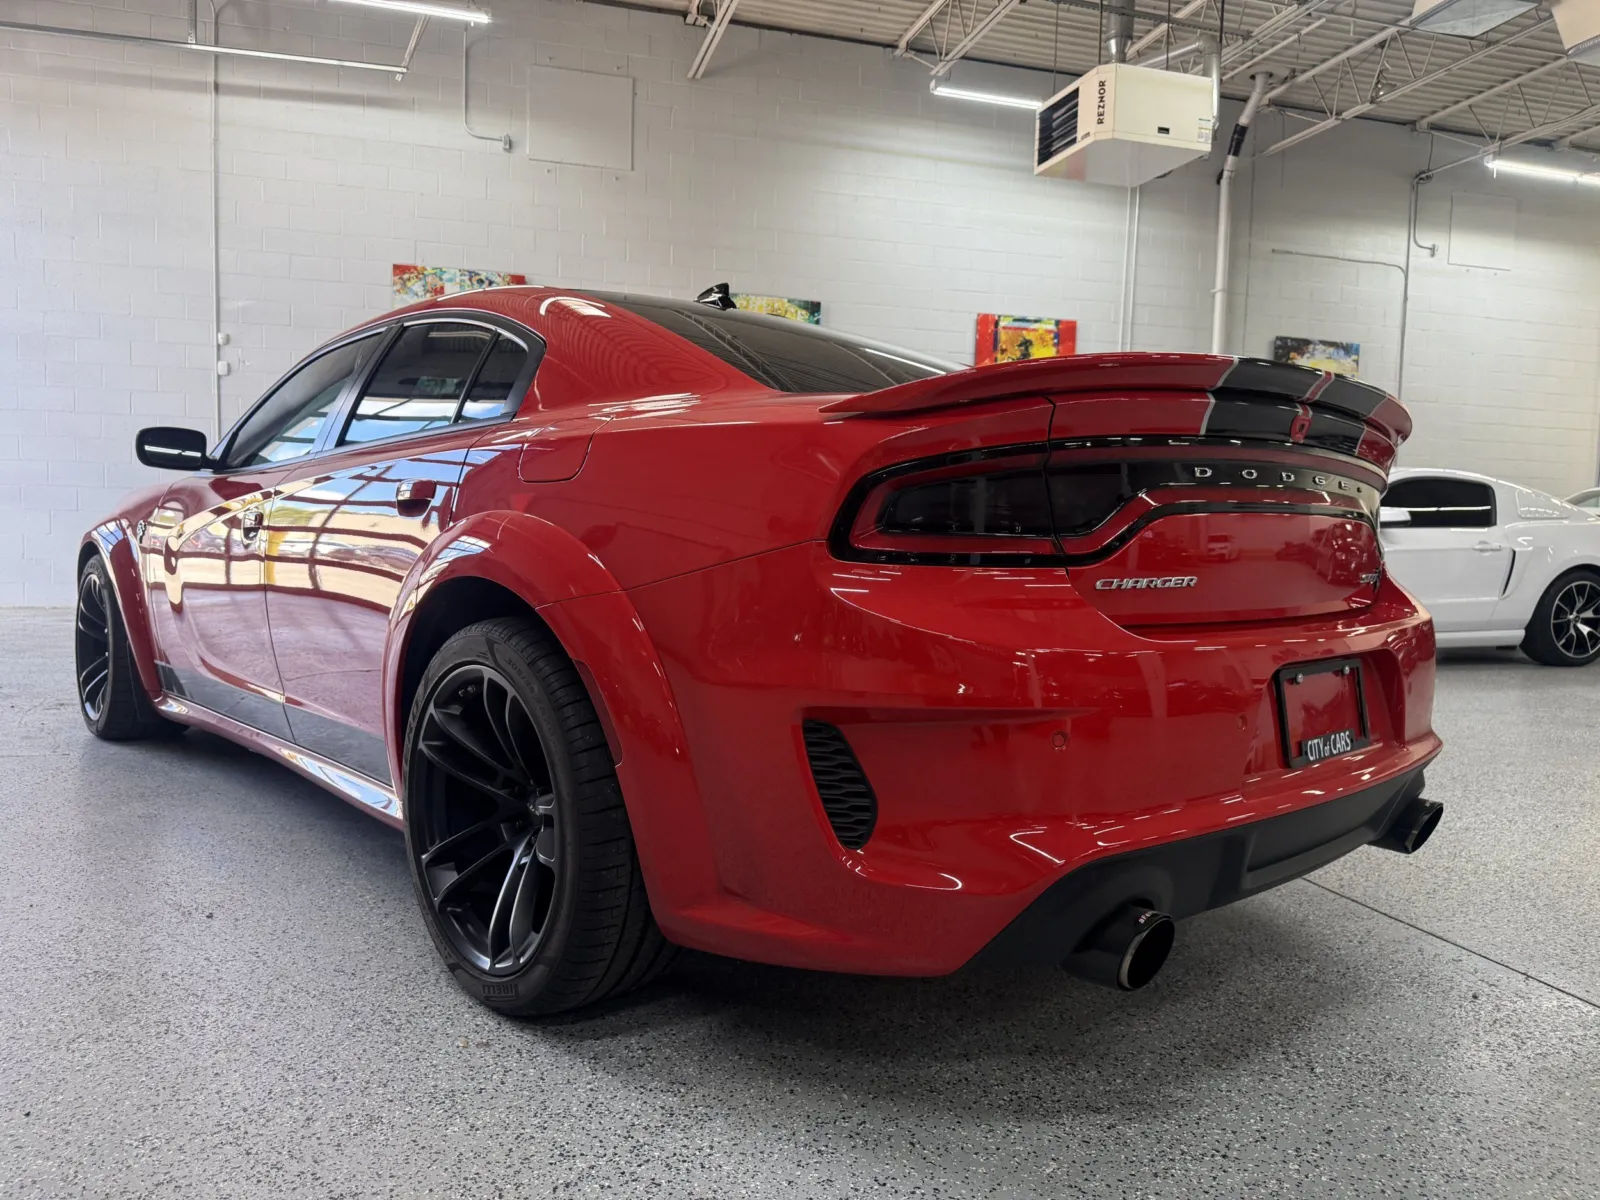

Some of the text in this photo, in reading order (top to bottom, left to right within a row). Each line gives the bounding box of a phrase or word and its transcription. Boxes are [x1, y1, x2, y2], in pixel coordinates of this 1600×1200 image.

[1097, 79, 1107, 125] REZNOR
[1194, 467, 1350, 490] DODGE
[1095, 576, 1198, 590] CHARGER
[1307, 731, 1351, 761] CITY of CARS
[482, 983, 519, 1001] PIRELLI
